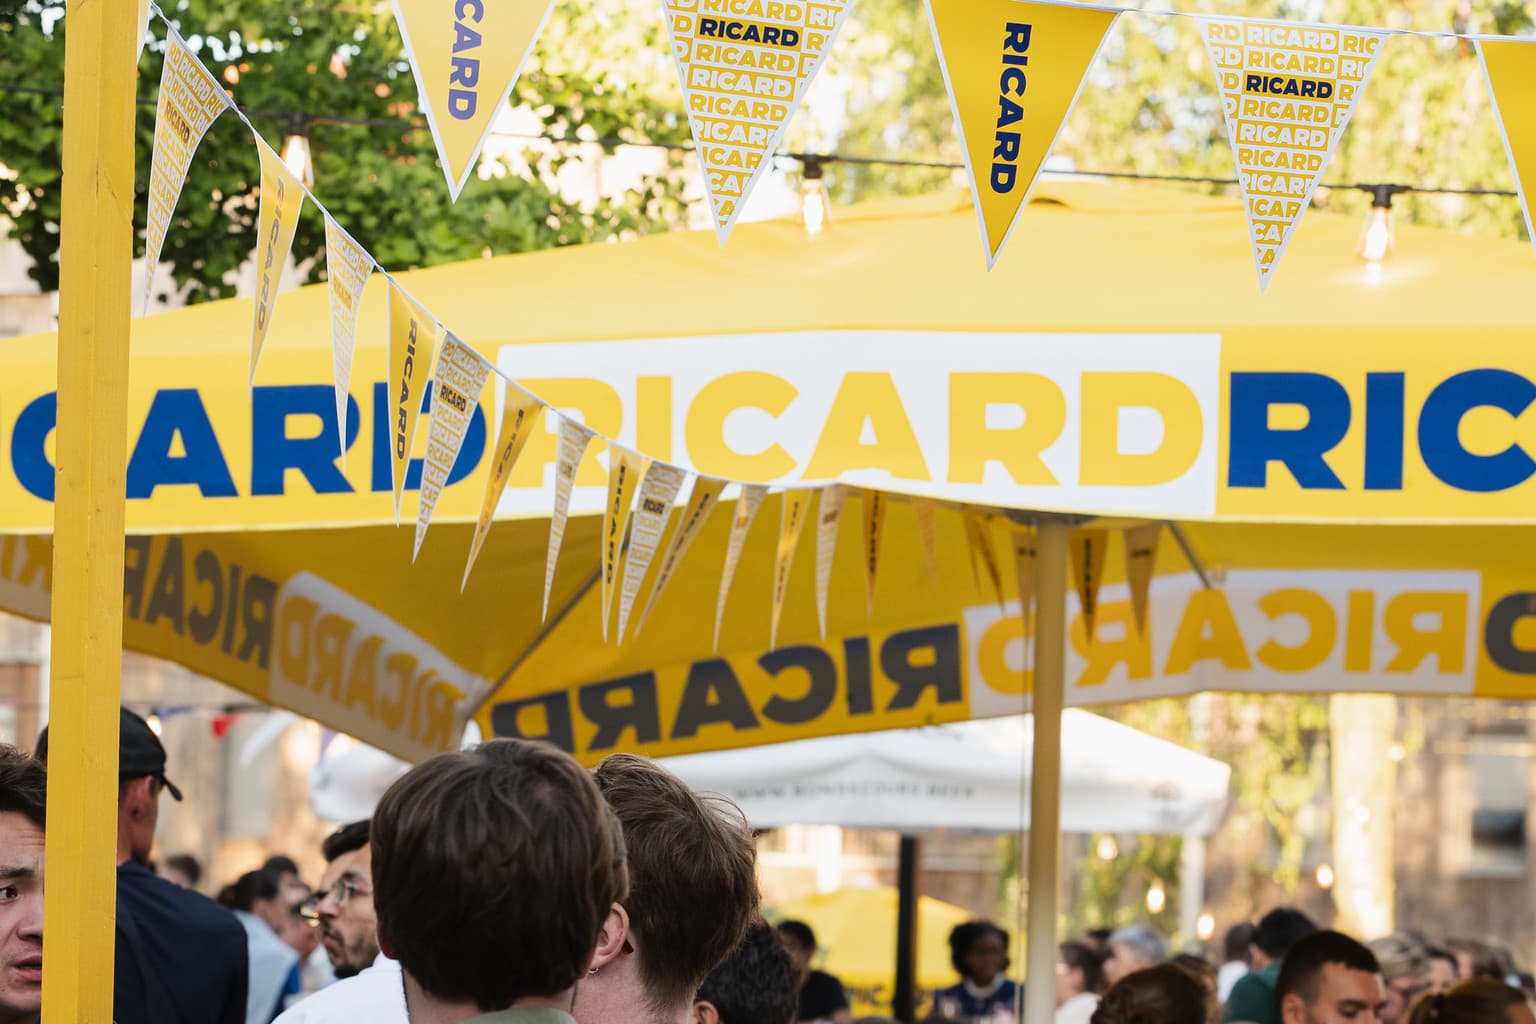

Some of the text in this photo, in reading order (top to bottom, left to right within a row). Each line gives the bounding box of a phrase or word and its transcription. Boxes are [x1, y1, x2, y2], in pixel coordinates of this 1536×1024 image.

[700, 18, 799, 47] RICARD
[1247, 25, 1337, 50] RICARD
[696, 44, 795, 71] RICARD
[1248, 51, 1335, 74] RICARD
[181, 54, 210, 101] RICARD
[691, 70, 792, 97] RICARD
[1246, 74, 1332, 98] RICARD
[171, 78, 199, 122] RICARD
[690, 93, 788, 121] RICARD
[990, 22, 1032, 194] RICARD
[1243, 99, 1330, 123] RICARD
[164, 100, 190, 144] RICARD
[1240, 124, 1327, 148] RICARD
[1238, 148, 1323, 171] RICARD
[258, 176, 285, 331] RICARD
[397, 318, 418, 460] RICARD
[440, 385, 466, 412] RICARD
[507, 370, 1204, 488] RICARD
[1227, 368, 1536, 493] RIC
